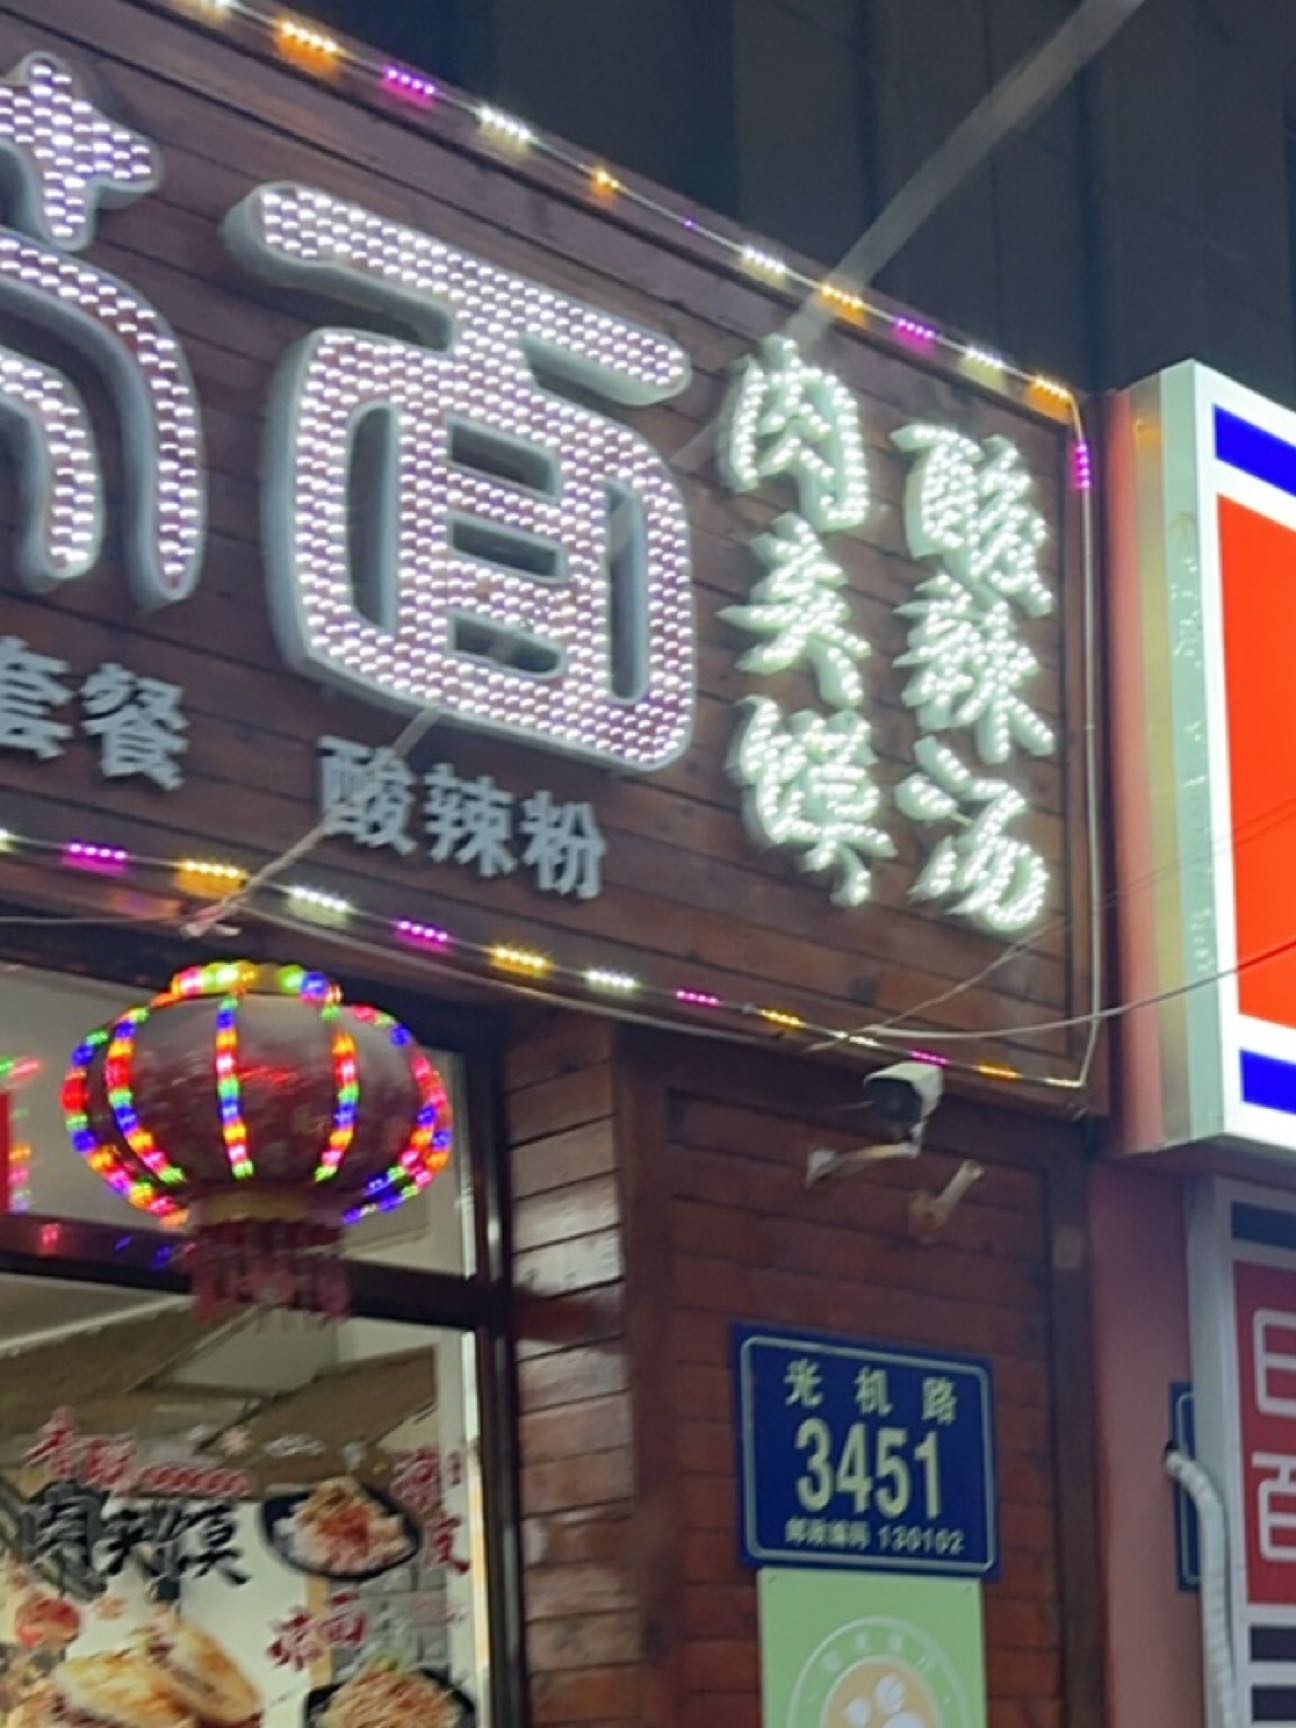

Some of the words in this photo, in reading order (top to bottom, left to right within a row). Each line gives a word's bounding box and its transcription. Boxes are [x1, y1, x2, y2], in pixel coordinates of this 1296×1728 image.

[716, 334, 896, 906] 肉夹馍
[890, 424, 1053, 934] 酸辣汤
[317, 735, 606, 899] 酸辣粉
[784, 1359, 956, 1425] 光机路
[794, 1417, 941, 1519] 3451
